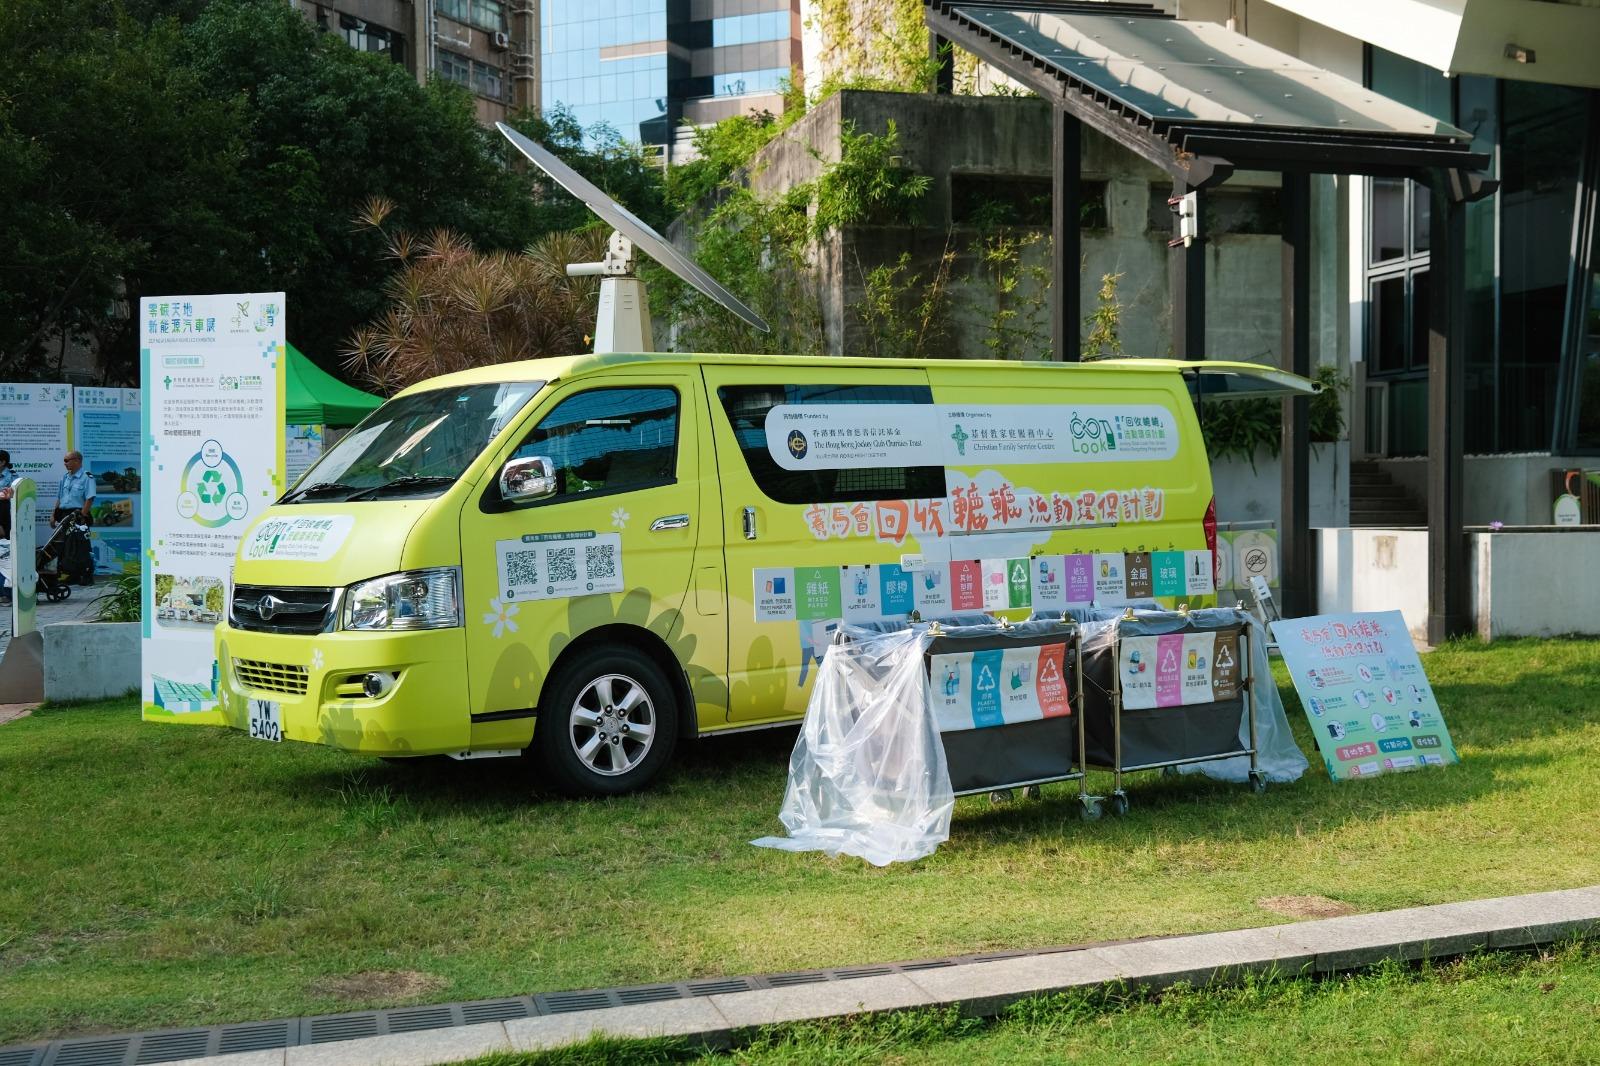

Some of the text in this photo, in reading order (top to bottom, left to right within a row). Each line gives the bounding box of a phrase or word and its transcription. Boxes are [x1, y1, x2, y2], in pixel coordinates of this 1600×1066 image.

[148, 302, 193, 317] 零碳天地
[148, 317, 216, 333] 新能源汽車展
[1130, 567, 1148, 580] 金屬
[1160, 567, 1177, 579] 玻璃
[257, 700, 271, 720] YW
[252, 718, 279, 741] 5402
